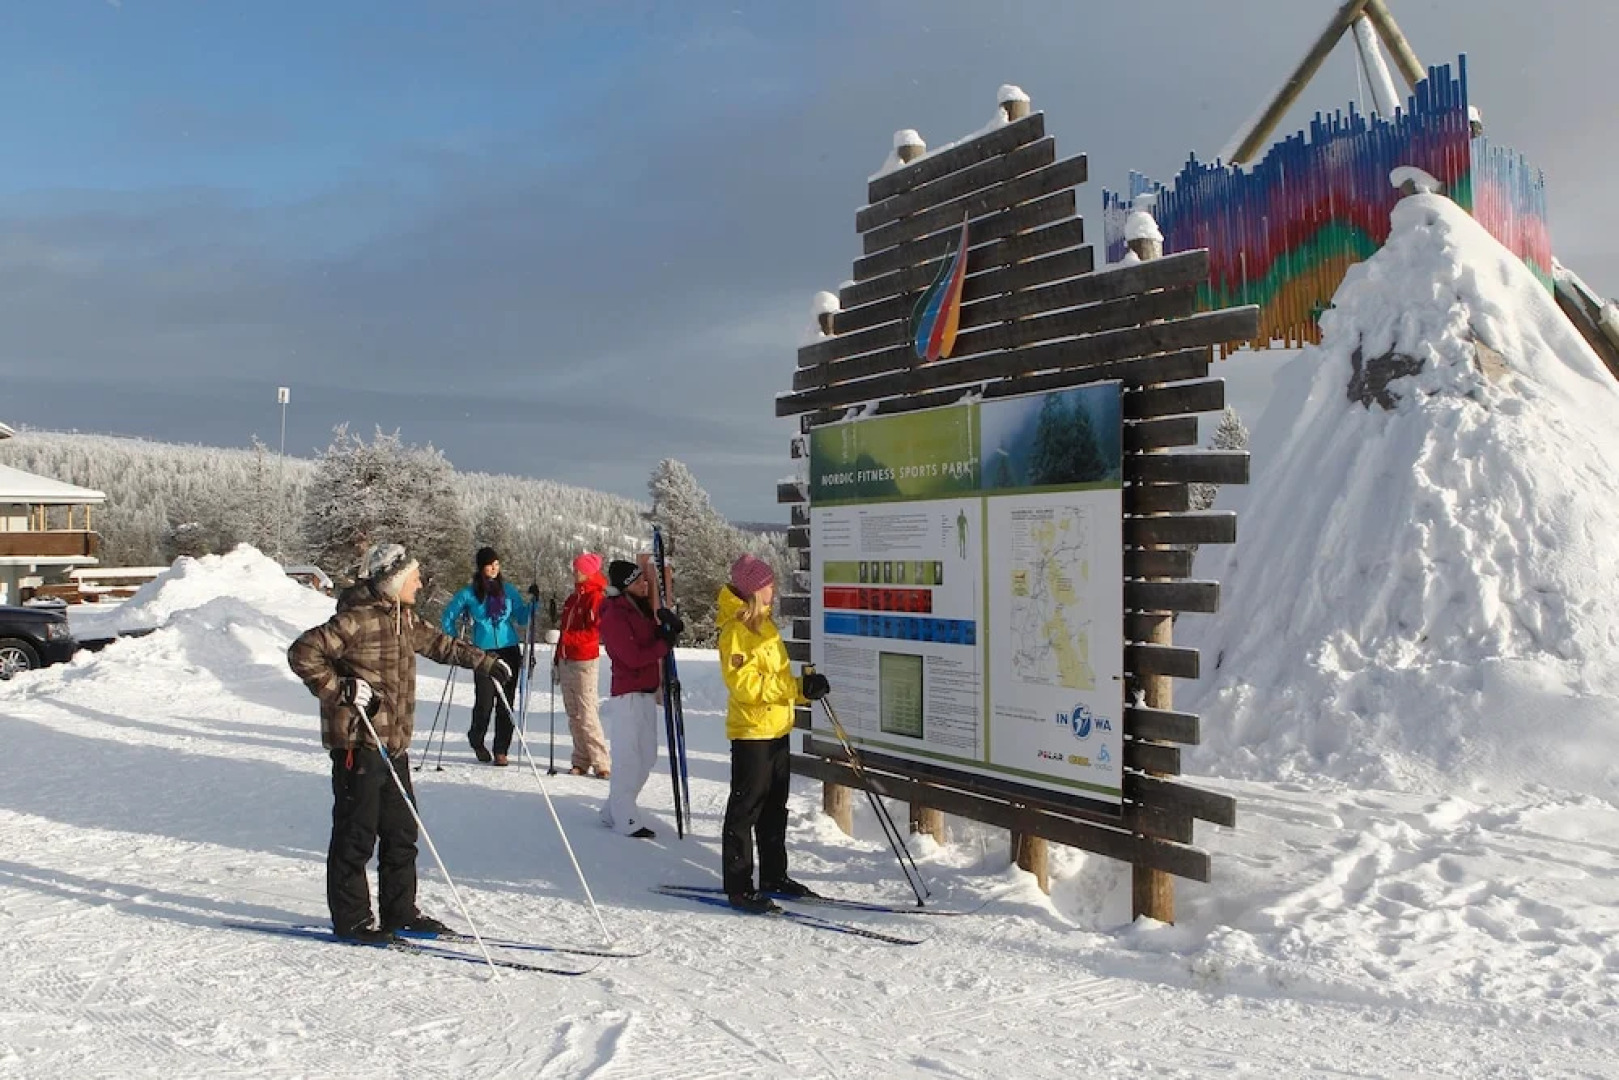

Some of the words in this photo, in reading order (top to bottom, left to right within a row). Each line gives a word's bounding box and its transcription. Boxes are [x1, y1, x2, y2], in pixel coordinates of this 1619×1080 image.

[821, 472, 854, 486] NORDIC
[857, 468, 895, 482] FITNESS
[899, 465, 937, 478] SPORTS
